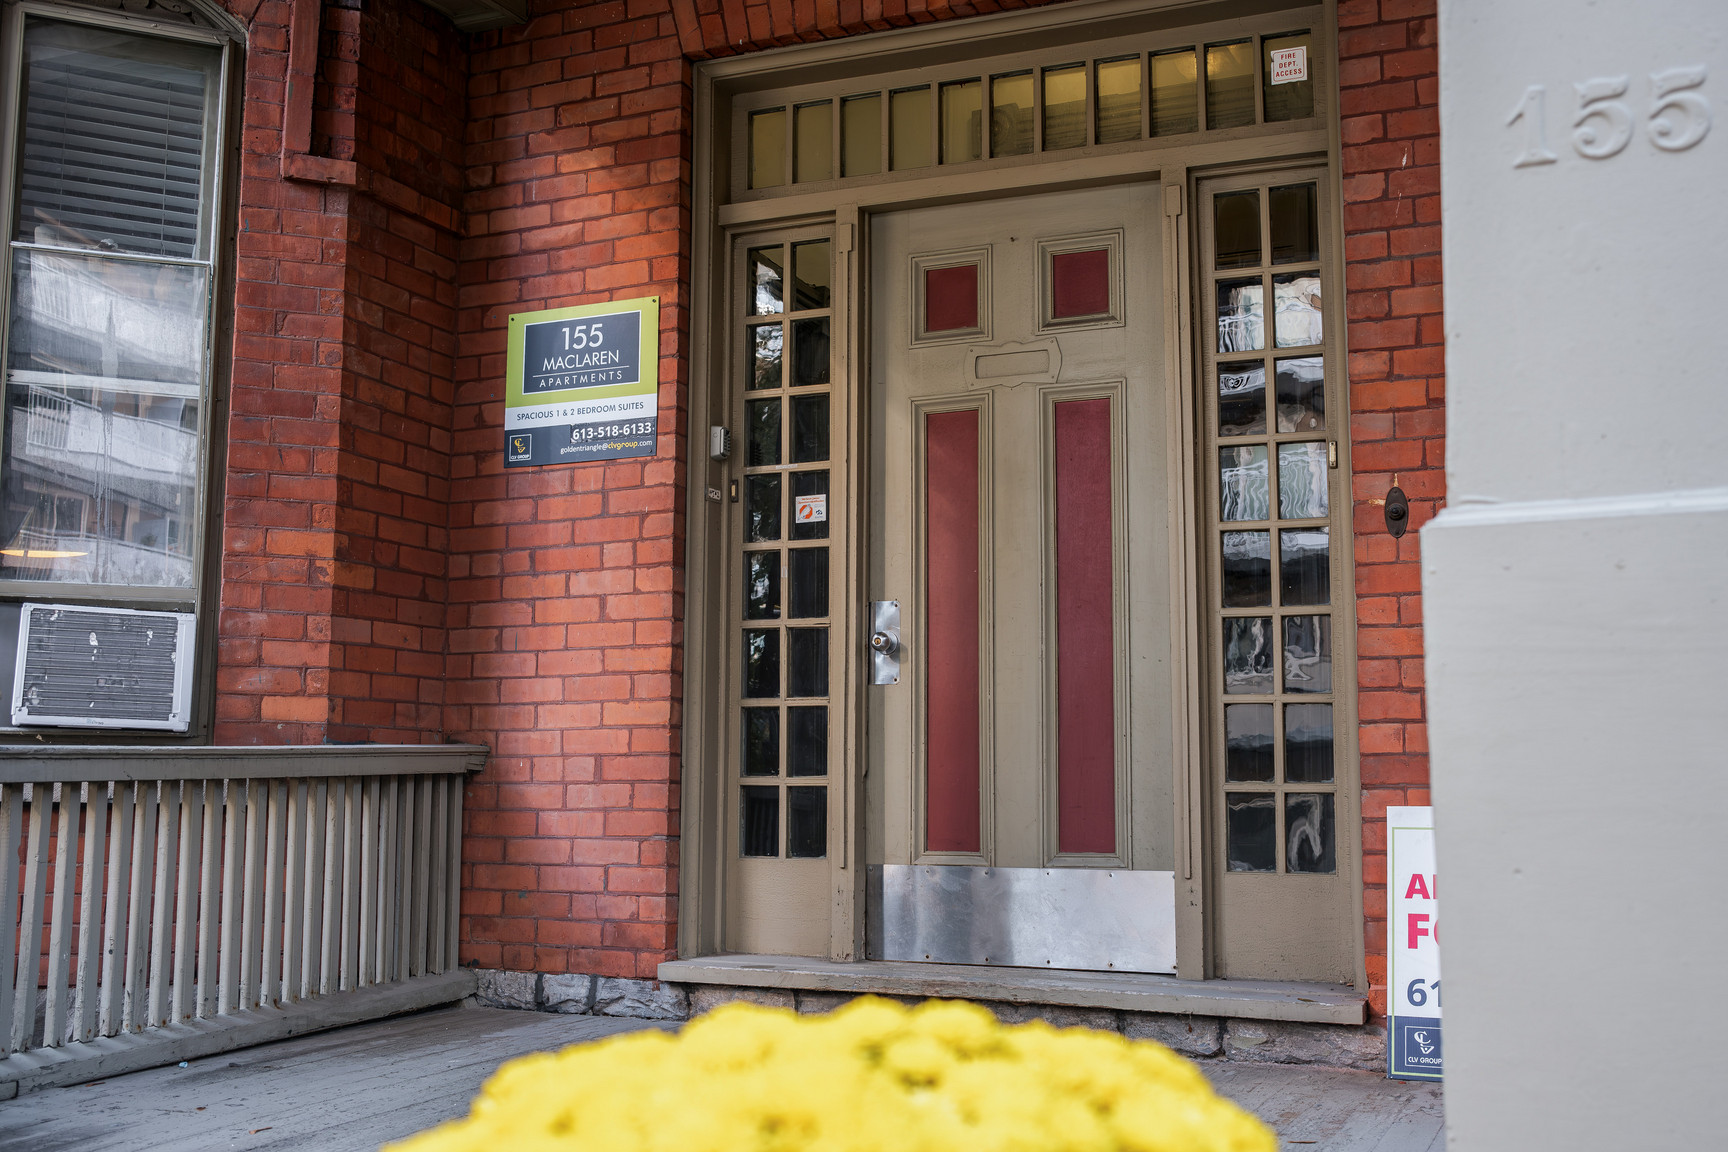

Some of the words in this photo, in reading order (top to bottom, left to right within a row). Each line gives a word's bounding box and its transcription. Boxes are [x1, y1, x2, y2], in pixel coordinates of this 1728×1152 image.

[1279, 61, 1298, 69] DEPT.
[1281, 52, 1296, 60] FIRE
[1276, 68, 1302, 77] ACCESS
[1506, 64, 1712, 169] 155
[561, 323, 604, 350] 155
[542, 350, 619, 371] MACLAREN
[539, 370, 623, 388] APARTMENTS
[517, 410, 554, 421] SPACIOUS
[570, 408, 575, 416] 2
[577, 404, 616, 415] BEDROOM
[618, 401, 644, 411] SUITES
[572, 422, 652, 440] 613-518-6133
[560, 439, 653, 455] goldentriangle@clvgroup.com
[1420, 1057, 1443, 1065] GROUP
